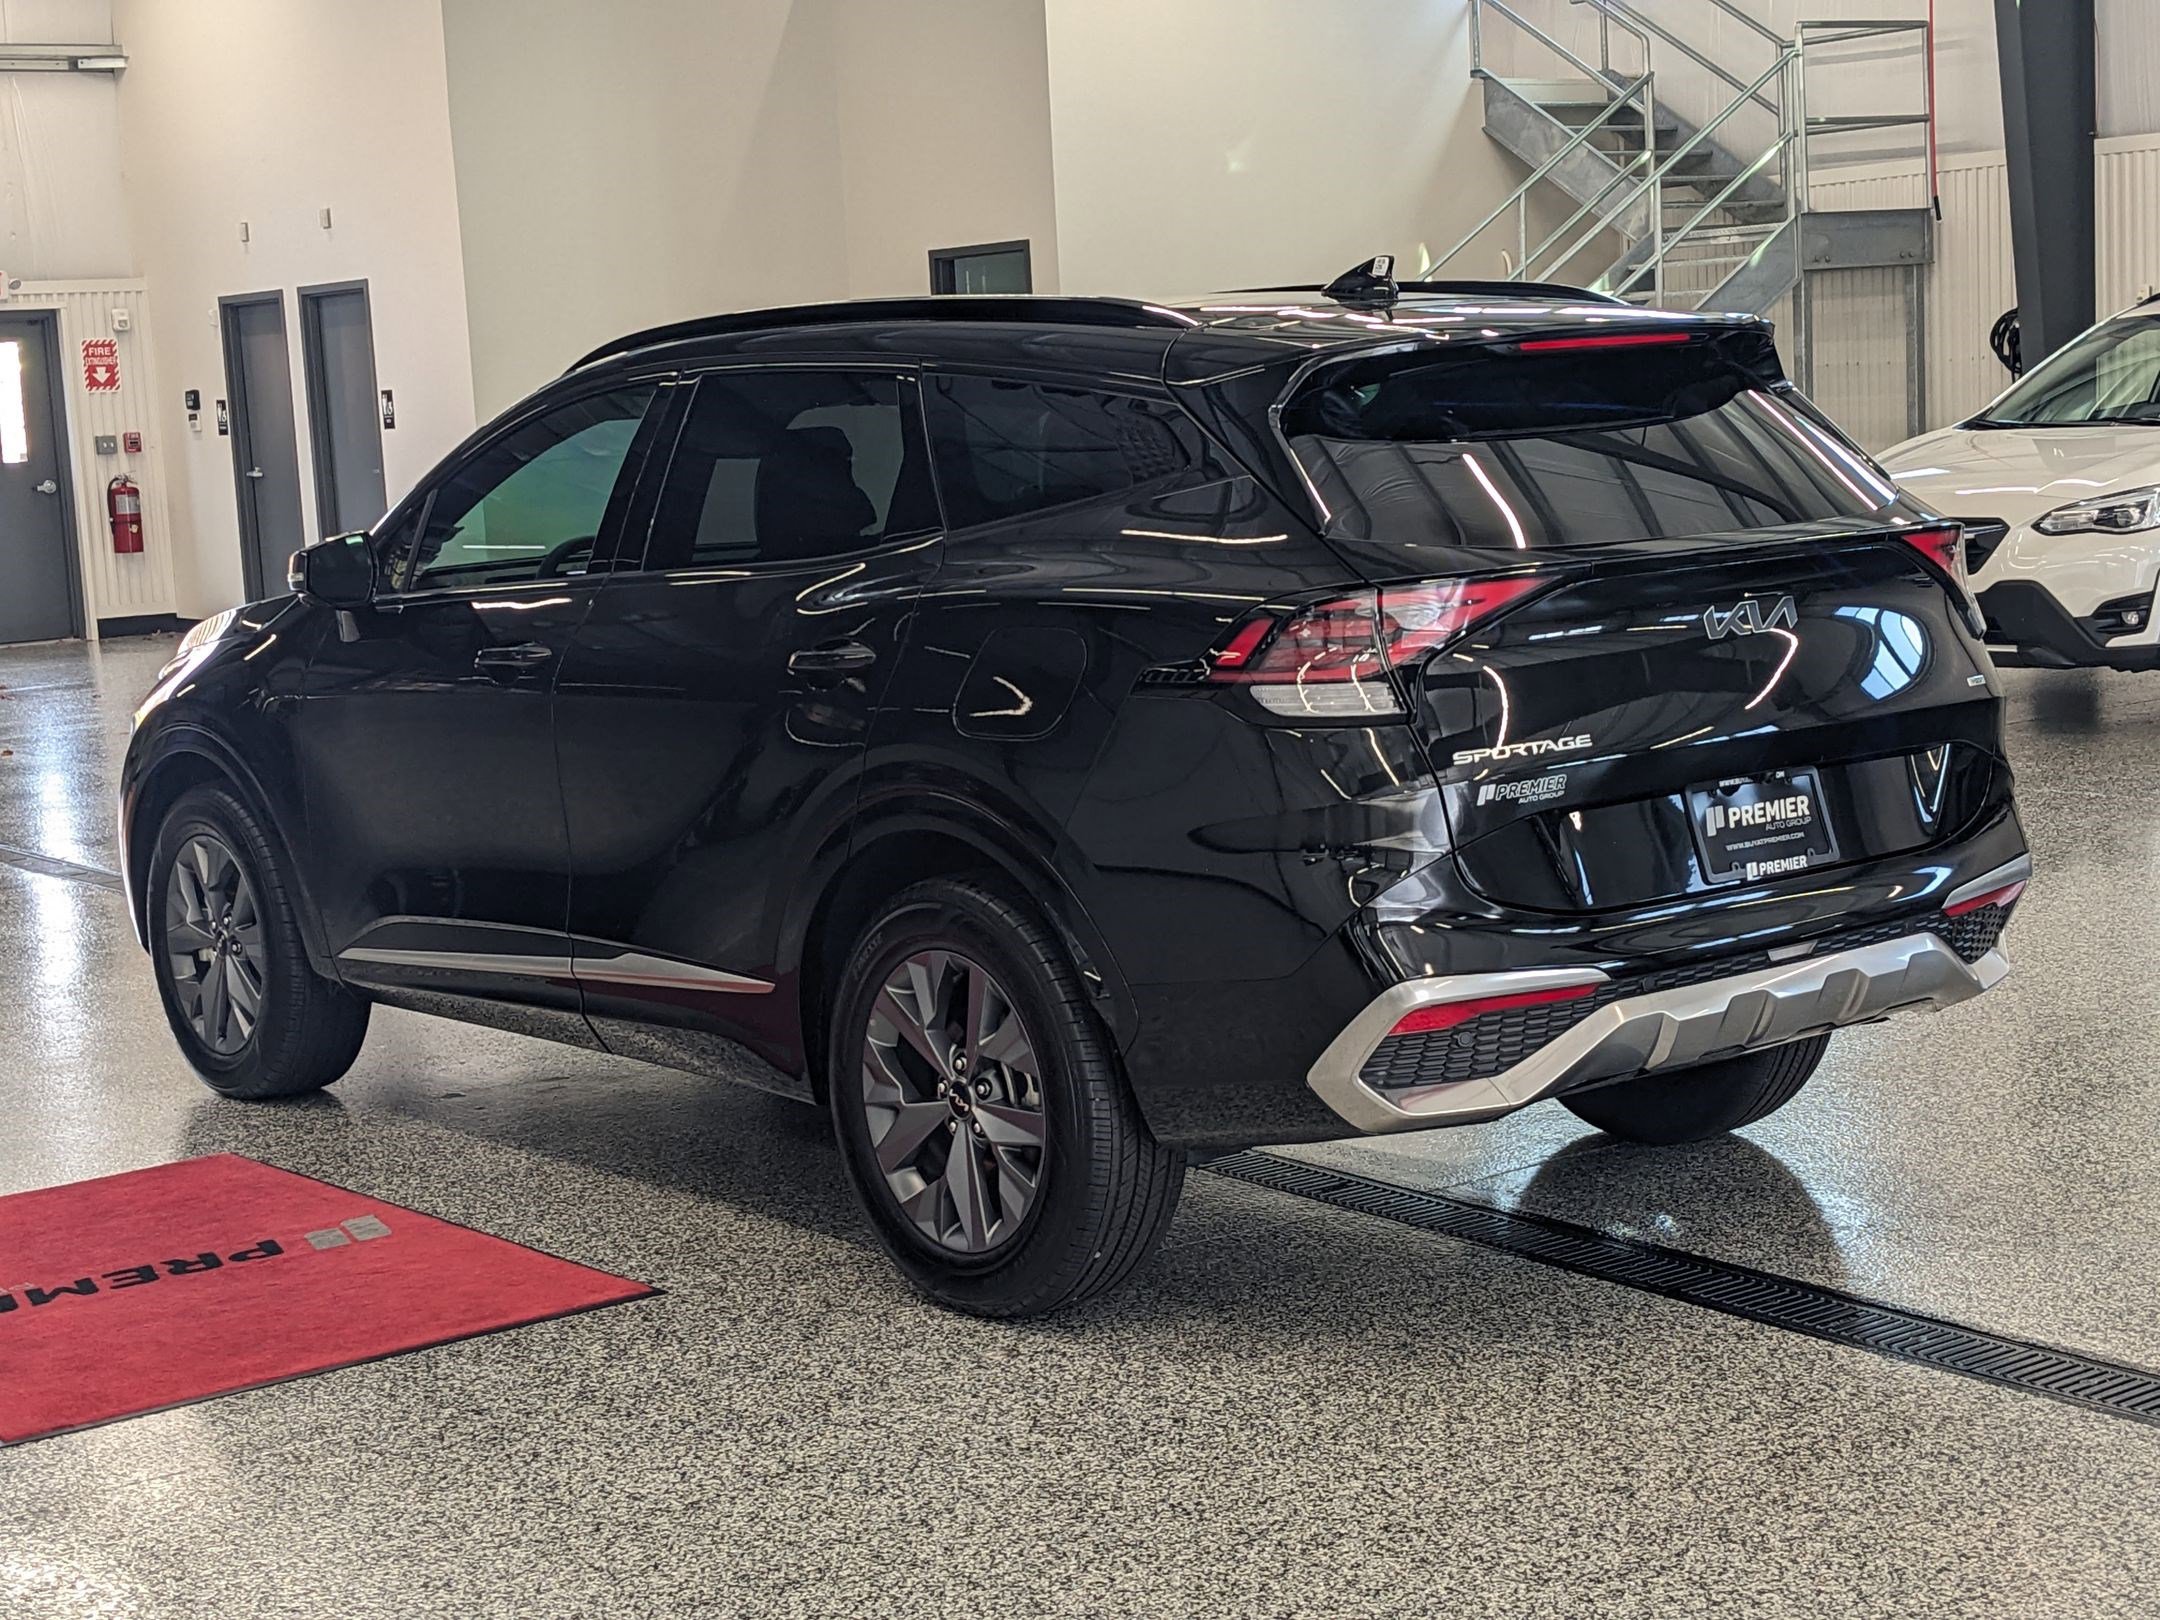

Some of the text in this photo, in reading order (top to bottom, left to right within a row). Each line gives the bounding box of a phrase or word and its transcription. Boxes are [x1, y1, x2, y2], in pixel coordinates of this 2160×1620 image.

[88, 347, 111, 356] FIRE
[1703, 595, 1798, 640] KIA
[1452, 734, 1593, 765] SPORTAGE
[1495, 773, 1568, 801] PREMIER
[1518, 790, 1565, 804] AUTO GROUP
[1728, 795, 1810, 829] PREMIER
[1765, 816, 1812, 832] AUTO GROUP
[1759, 855, 1808, 876] PREMIER
